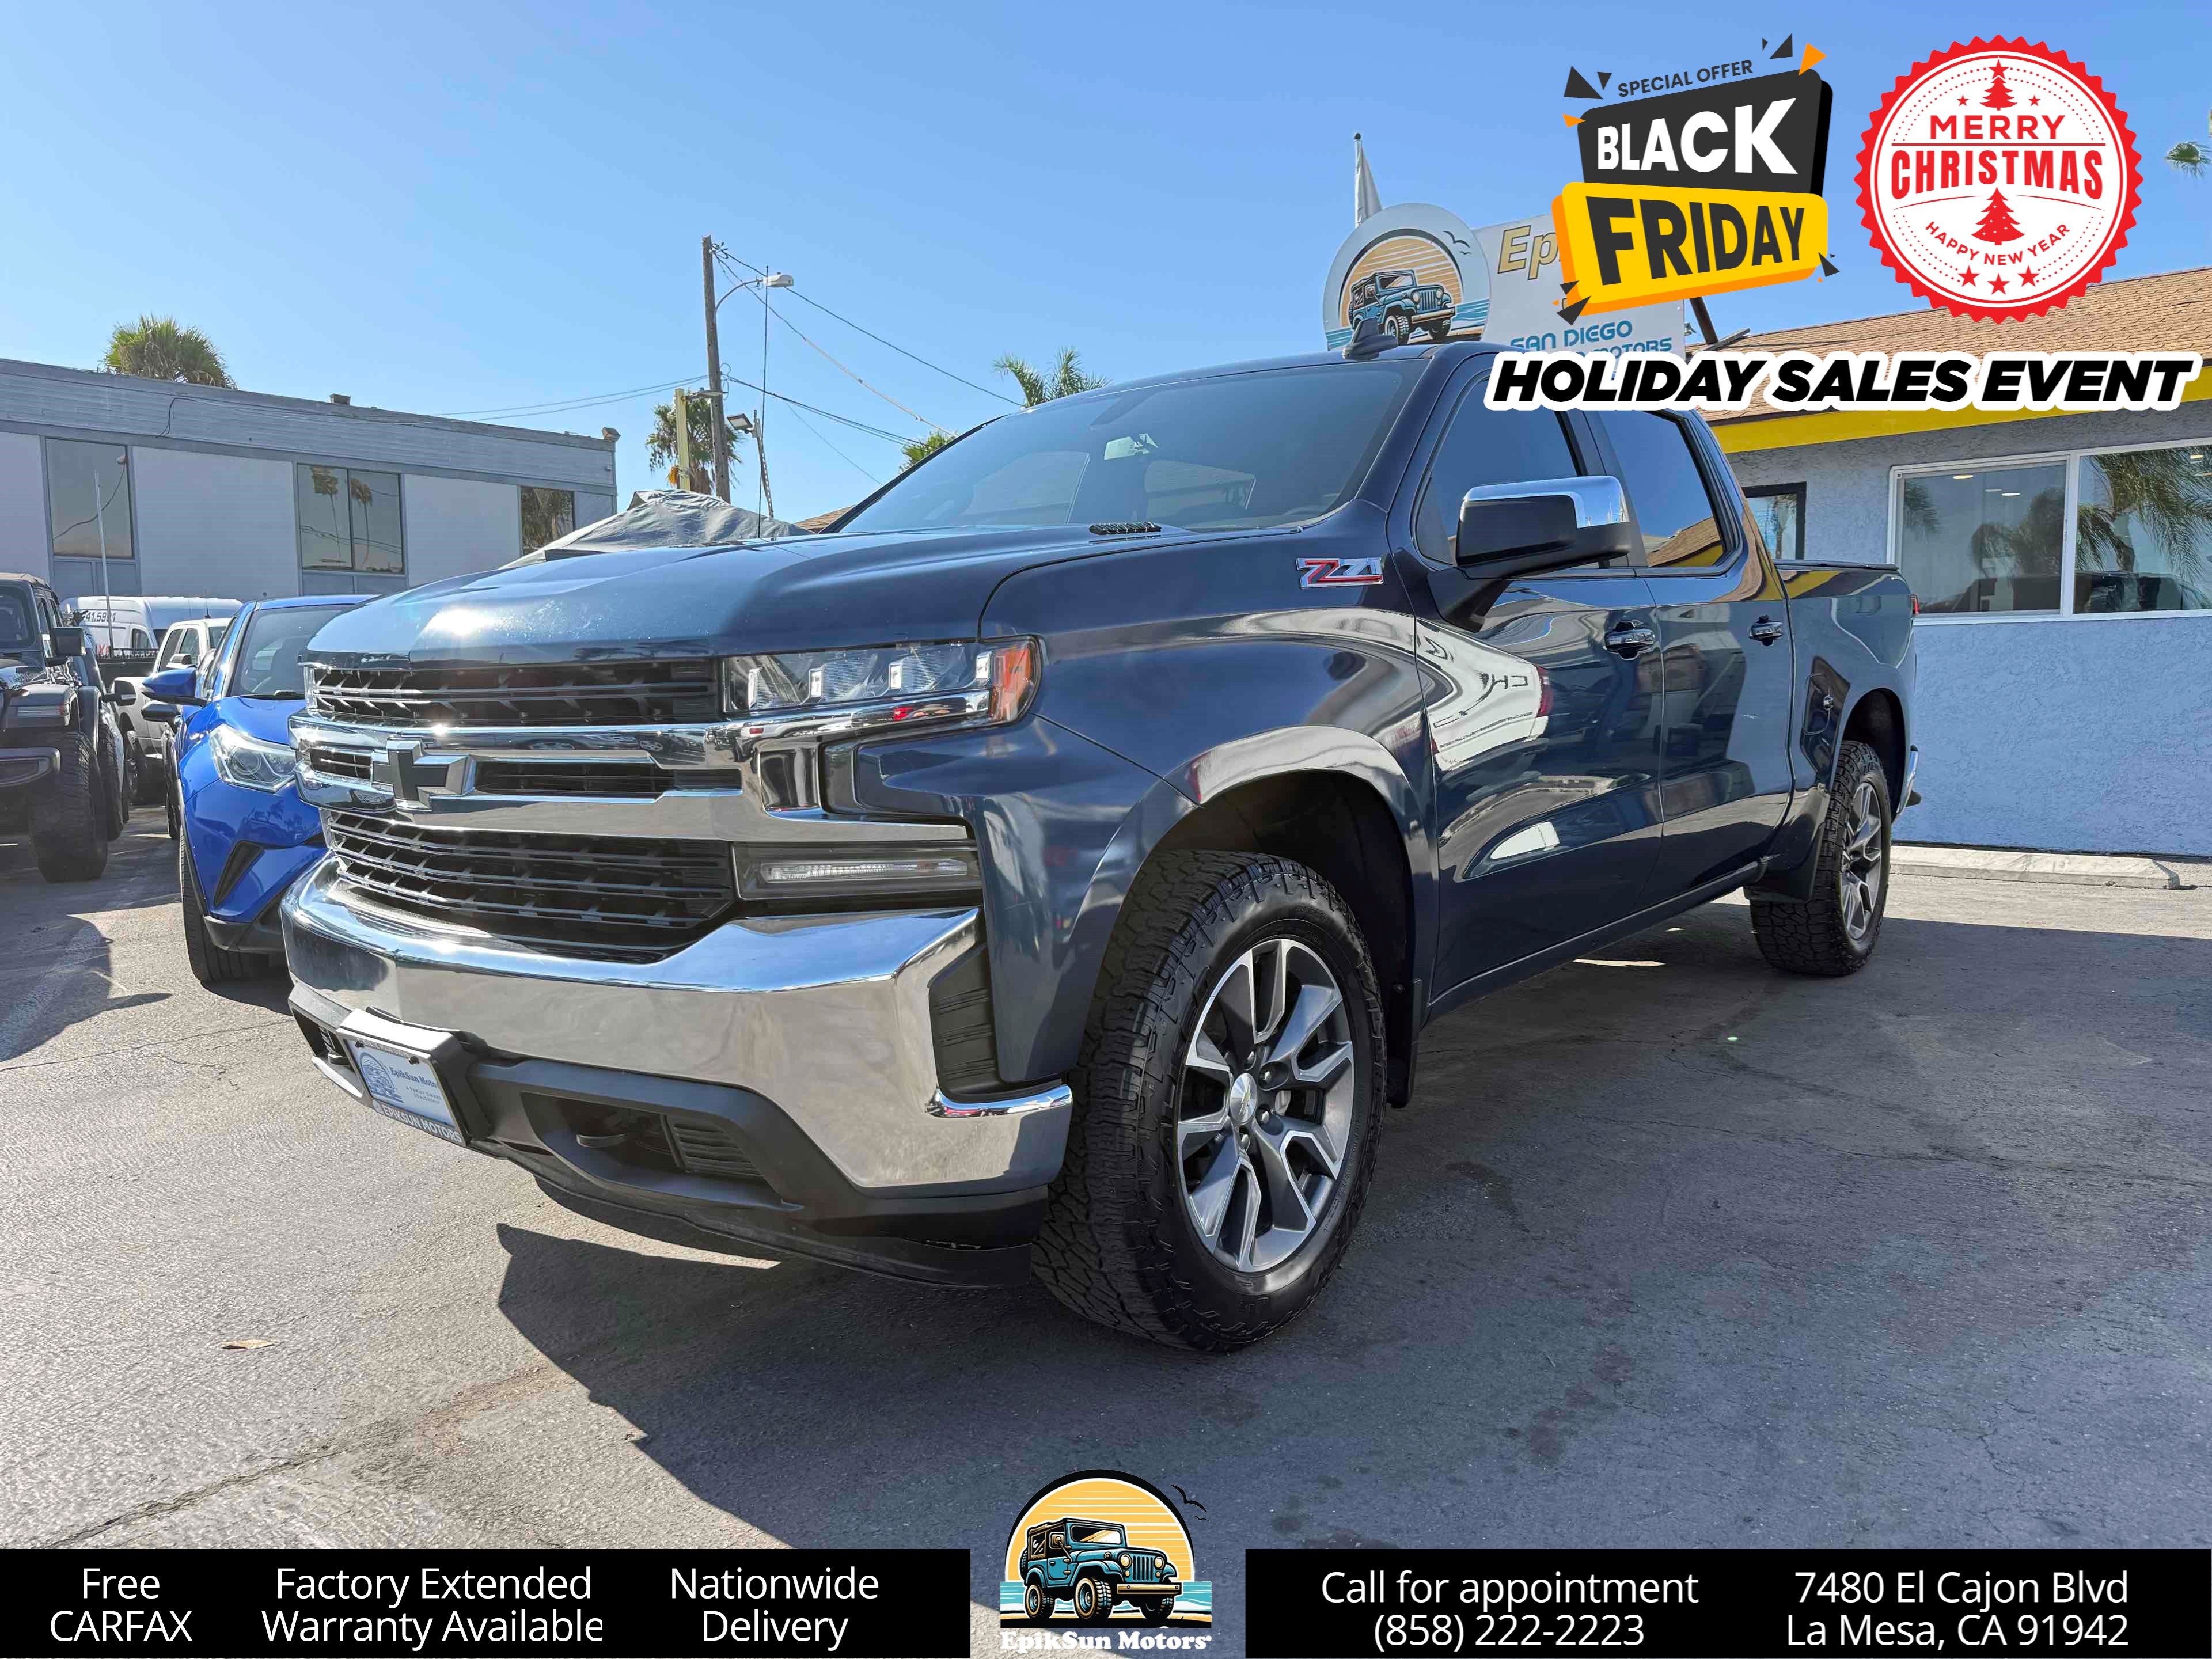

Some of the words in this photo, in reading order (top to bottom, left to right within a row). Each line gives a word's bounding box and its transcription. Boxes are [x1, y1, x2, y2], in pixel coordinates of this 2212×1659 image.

[1510, 332, 1557, 352] SAN
[1564, 320, 1633, 347] DIEGO
[1593, 337, 1672, 359] OTORS
[1296, 557, 1383, 588] Z71
[381, 1104, 422, 1129] EPIKSUN
[420, 1119, 462, 1143] MOTORS
